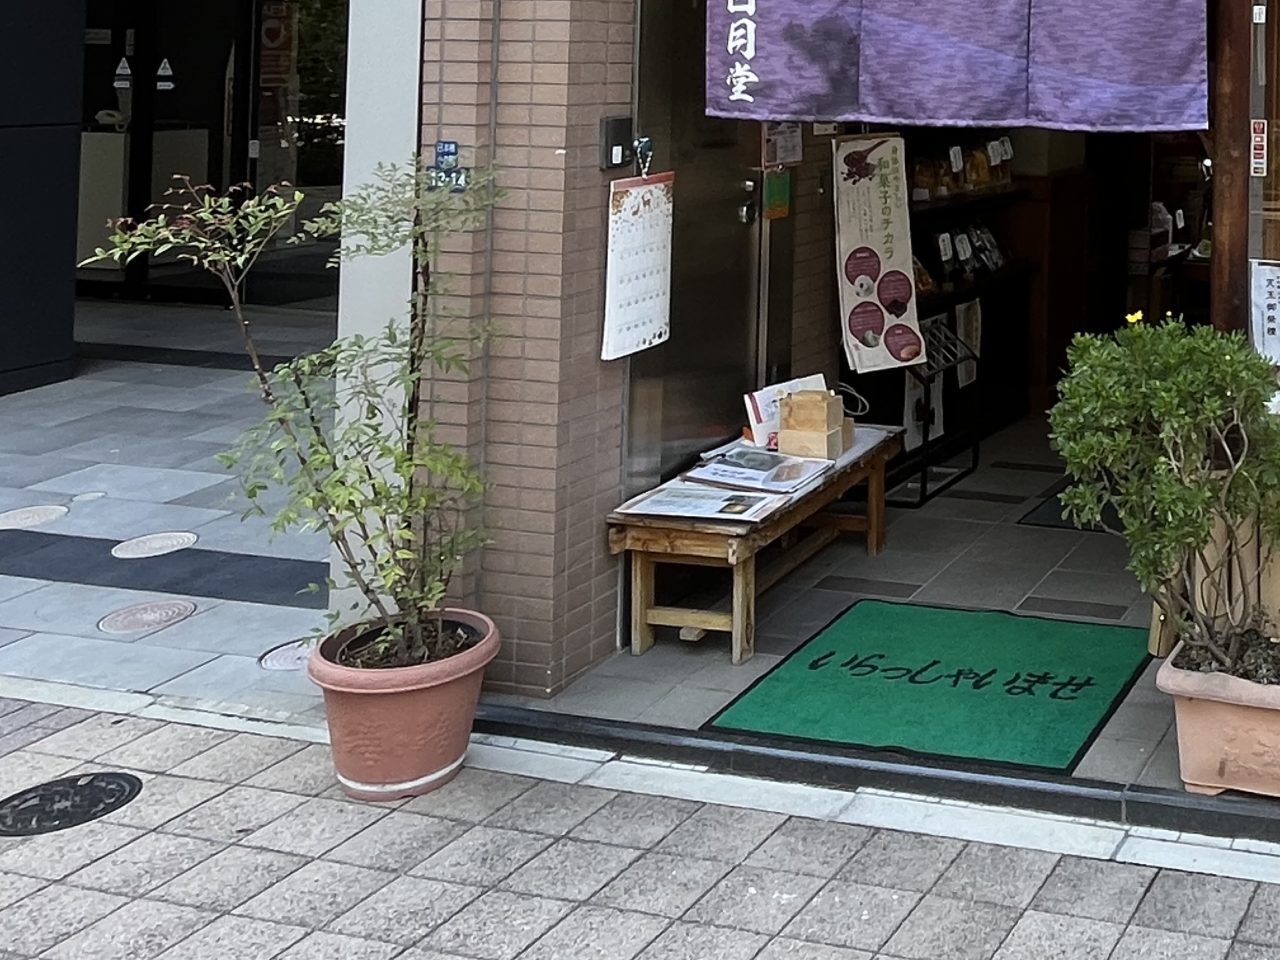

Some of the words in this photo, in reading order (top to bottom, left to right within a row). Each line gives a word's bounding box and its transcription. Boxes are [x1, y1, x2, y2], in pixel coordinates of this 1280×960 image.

[878, 157, 894, 259] 和菓子のチカラ
[807, 650, 1098, 701] いらっしゃいませ
